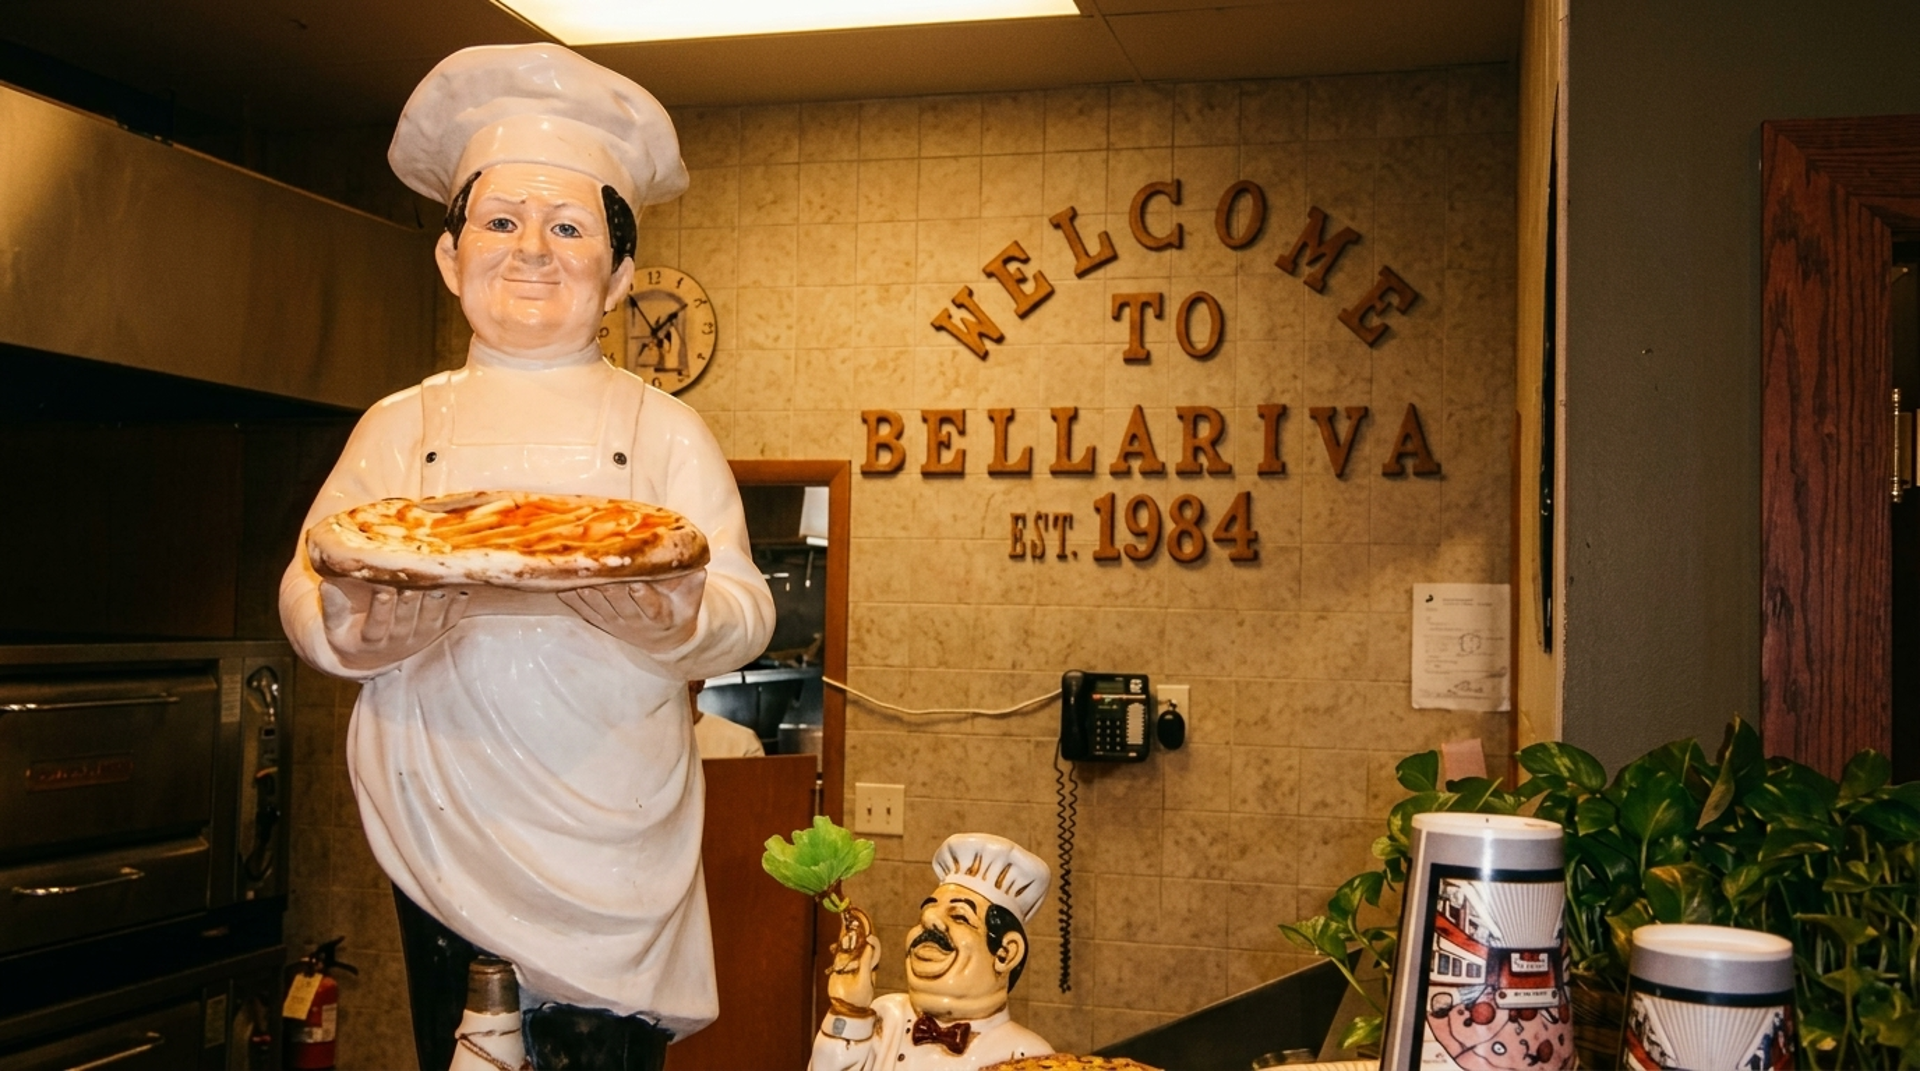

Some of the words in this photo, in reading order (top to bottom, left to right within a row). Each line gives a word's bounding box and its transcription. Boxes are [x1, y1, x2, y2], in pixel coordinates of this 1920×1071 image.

[648, 271, 661, 285] 12
[931, 179, 1420, 361] WELCOME
[1112, 291, 1225, 363] TO
[860, 403, 1442, 477] BELLARIVA
[1008, 510, 1079, 560] EST.
[1093, 491, 1259, 562] 1984
